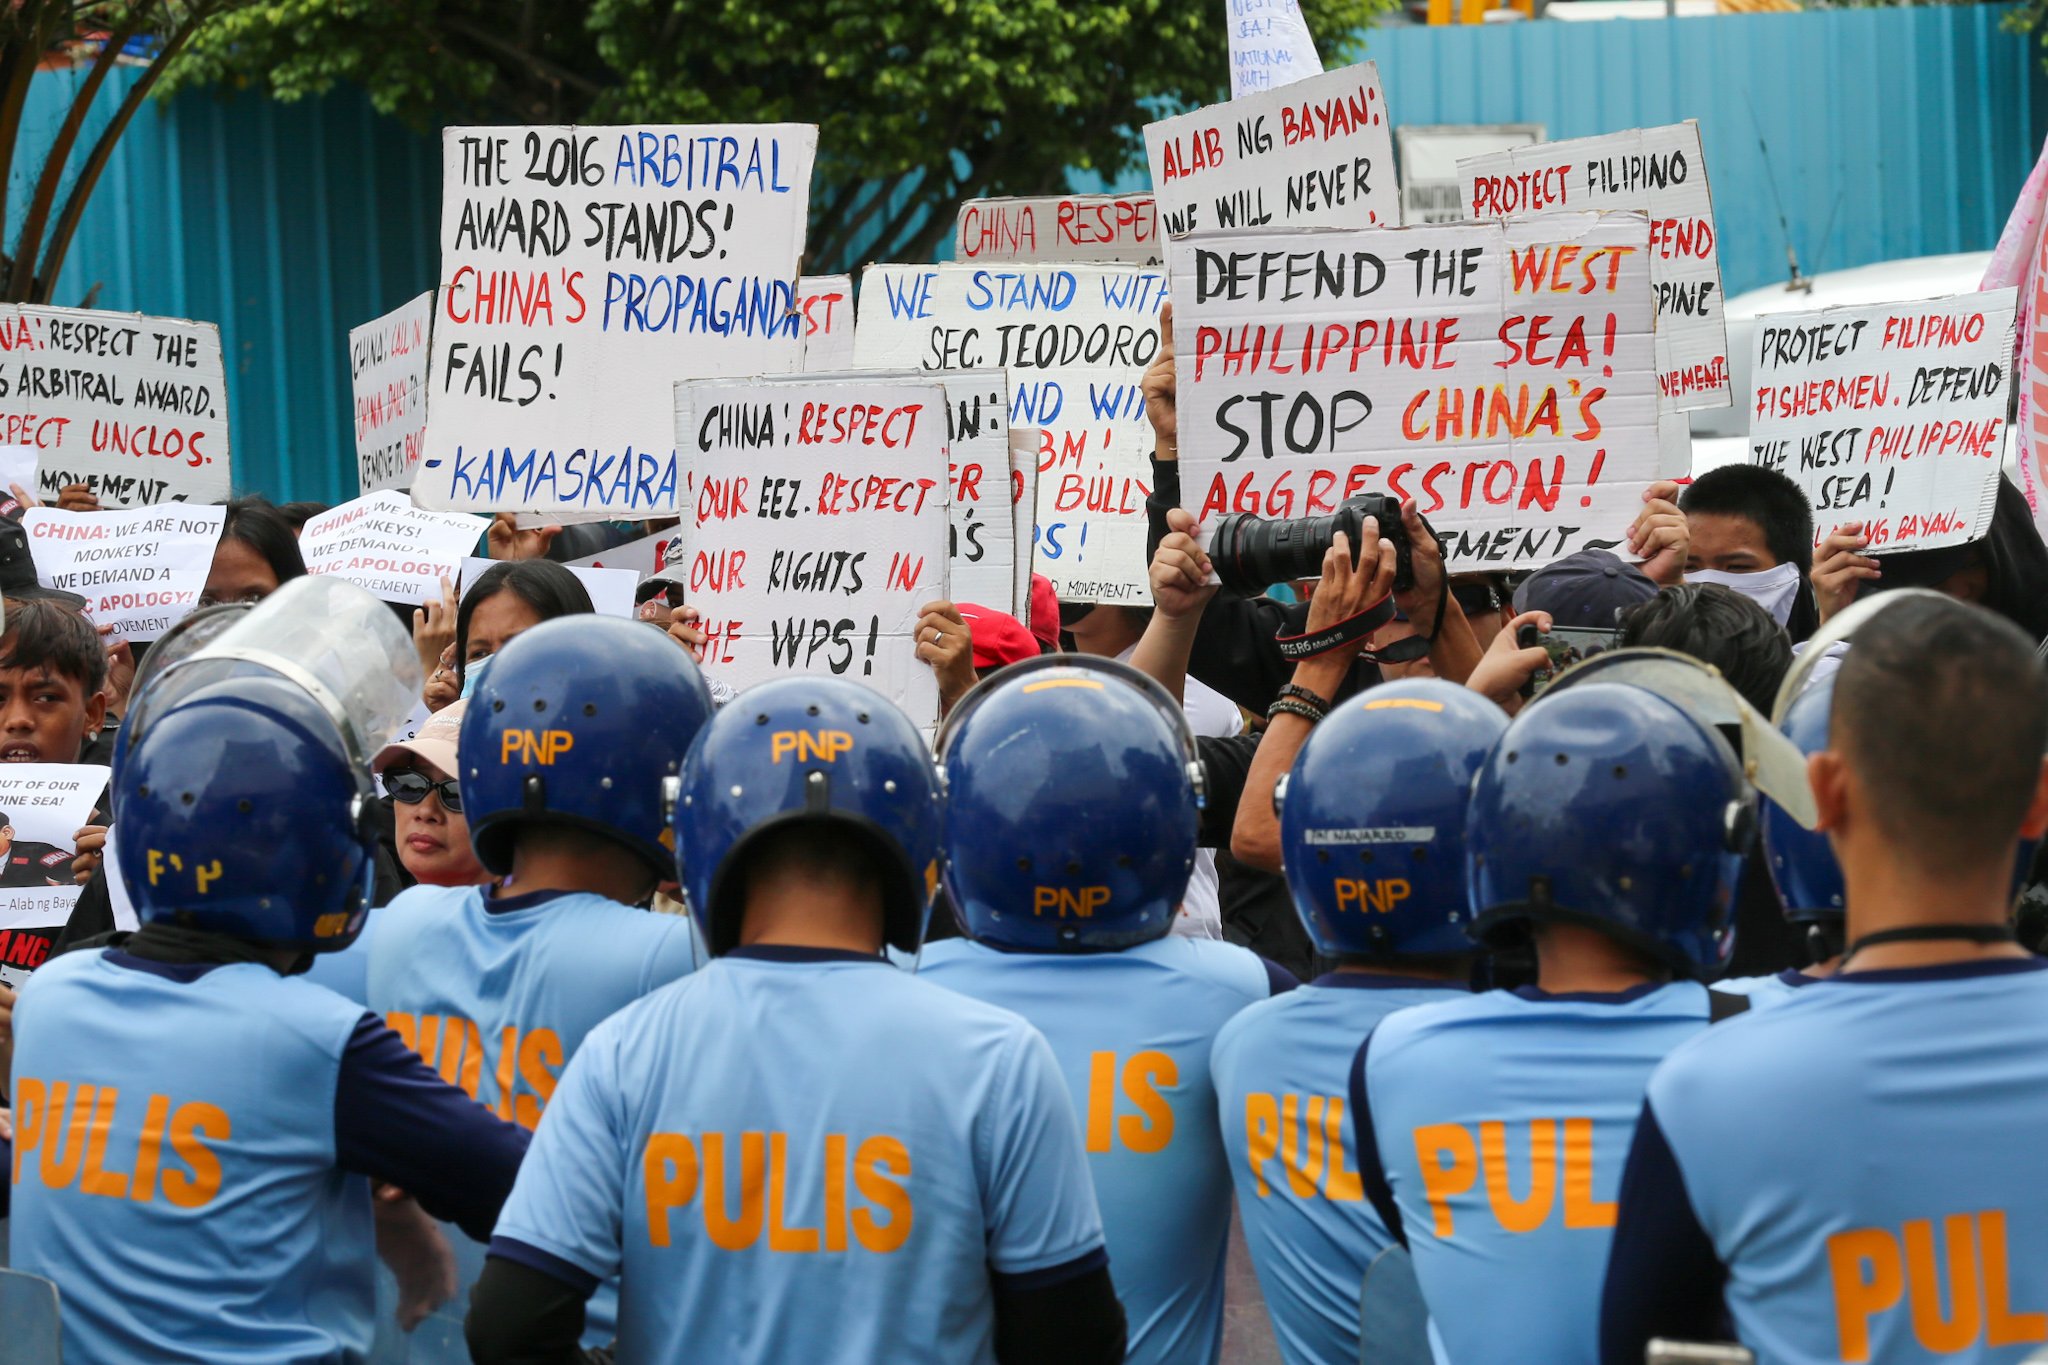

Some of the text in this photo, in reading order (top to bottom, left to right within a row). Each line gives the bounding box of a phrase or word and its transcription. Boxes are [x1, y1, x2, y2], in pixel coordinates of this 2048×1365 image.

[1163, 85, 1379, 185] ALAB NG BAYAN:
[459, 131, 791, 193] THE 2016 ARBITRAL
[1472, 165, 1572, 218] PROTECT
[1588, 150, 1687, 198] FILIPINO
[1163, 203, 1197, 234] WE
[1215, 186, 1272, 228] WILL
[1286, 156, 1371, 218] NEVER
[455, 196, 734, 263] AWARD STANDS!
[963, 205, 1036, 257] CHINA
[1650, 217, 1713, 260] FEND
[446, 266, 587, 327] CHINA'S
[884, 273, 938, 321] WE
[966, 270, 1077, 312] STAND
[1195, 244, 1638, 304] DEFEND THE WEST
[797, 292, 844, 336] ST
[0, 315, 198, 368] NA: RESPECT THE
[354, 329, 388, 380] CHINA:
[391, 320, 409, 356] CALL
[923, 322, 1158, 370] SEC. TEODORO
[1194, 312, 1617, 383] PHILIPPINE SEA!
[1760, 320, 1868, 369] PROTECT
[1881, 313, 1985, 350] FILIPINO
[17, 363, 124, 406] ARBITRAL
[134, 377, 215, 419] AWARD.
[444, 342, 563, 407] FAILS!
[1756, 362, 2003, 422] FISHERMEN. DEFEND
[357, 391, 383, 442] CHINA
[698, 402, 924, 453] CHINA: RESPECT
[1008, 380, 1063, 425] ND
[1215, 378, 1607, 463] STOP CHINA'S
[91, 419, 212, 467] UNCLOS.
[362, 445, 393, 489] REMOVE
[1038, 427, 1111, 473] BM!
[1800, 427, 1863, 473] WEST
[1864, 417, 2003, 465] PHILIPPINE
[695, 472, 937, 530] OUR EEZ. RESPECT
[1199, 449, 1607, 524] AGGRESSION!
[1816, 466, 1895, 511] SEA!
[32, 518, 219, 541] CHINA: WE ARE NOT
[310, 506, 370, 538] CHINA:
[373, 501, 401, 515] WE
[443, 519, 482, 532] NOT
[336, 519, 422, 538] MONKEYS!
[74, 542, 159, 564] MONKEYS!
[307, 557, 452, 577] BLIC APOLOGY!
[312, 543, 336, 558] WE
[338, 536, 415, 553] DEMAND
[690, 549, 747, 593] OUR
[767, 548, 868, 595] RIGHTS
[886, 552, 924, 592] IN
[53, 567, 171, 589] WE DEMAND A
[100, 591, 194, 612] APOLOGY!
[110, 616, 170, 636] OVEMENT
[771, 614, 879, 676] WPS!
[1297, 640, 1312, 653] R6
[1312, 637, 1335, 650] Mark
[501, 729, 574, 765] PNP
[771, 731, 854, 764] PNP
[25, 780, 46, 790] OF
[48, 781, 80, 791] OUR
[31, 796, 65, 806] SEA!
[9, 898, 34, 911] Alab
[37, 898, 49, 912] ng
[1034, 887, 1111, 917] PNP
[1334, 878, 1411, 912] PNP
[1086, 1051, 1179, 1153] IS
[11, 1077, 231, 1208] PULIS
[1245, 1092, 1364, 1201] PUL
[643, 1131, 913, 1253] PULIS
[1413, 1117, 1618, 1238] PUL
[1826, 1209, 2048, 1363] PUL
